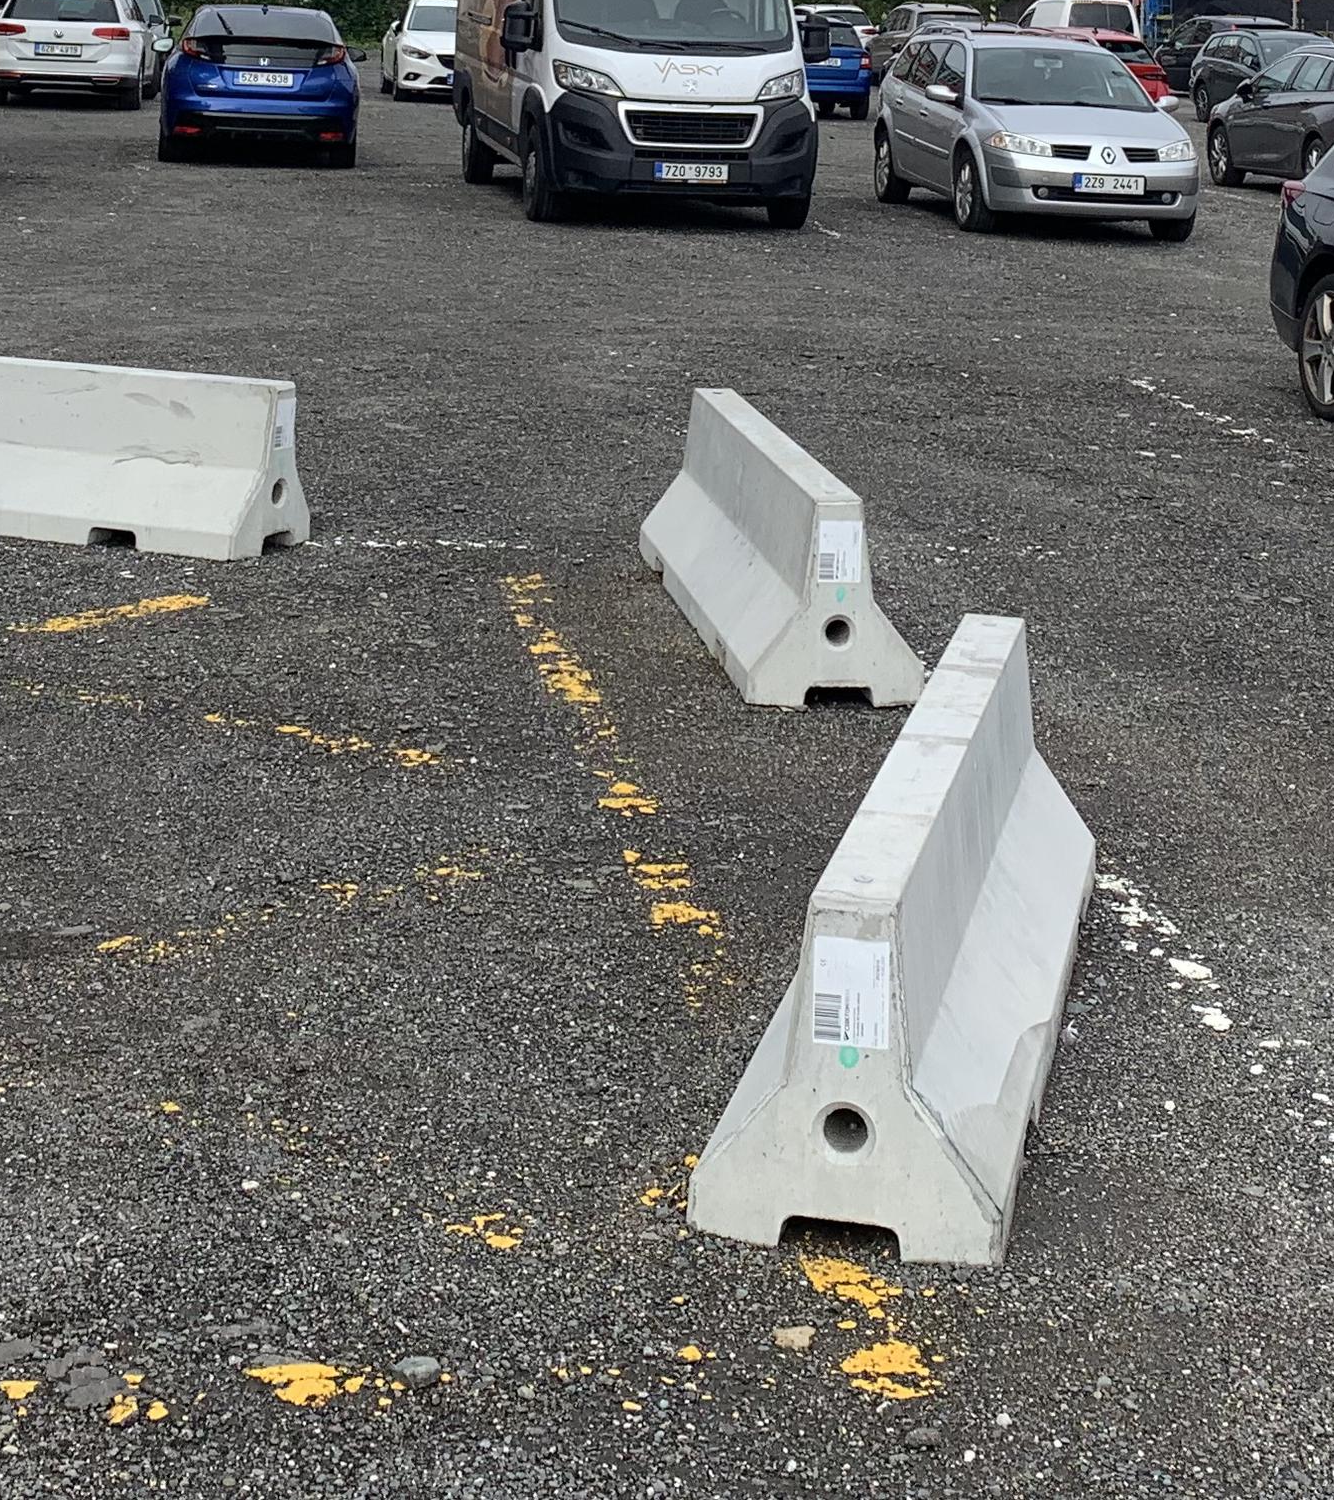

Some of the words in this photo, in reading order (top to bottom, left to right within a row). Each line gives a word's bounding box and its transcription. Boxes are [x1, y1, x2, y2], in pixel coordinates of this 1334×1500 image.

[241, 72, 259, 82] 5Z8
[266, 73, 289, 84] 4938
[665, 165, 686, 178] 7Z0
[694, 165, 723, 178] 9793
[1084, 176, 1105, 189] 2Z9
[1113, 178, 1139, 191] 2441
